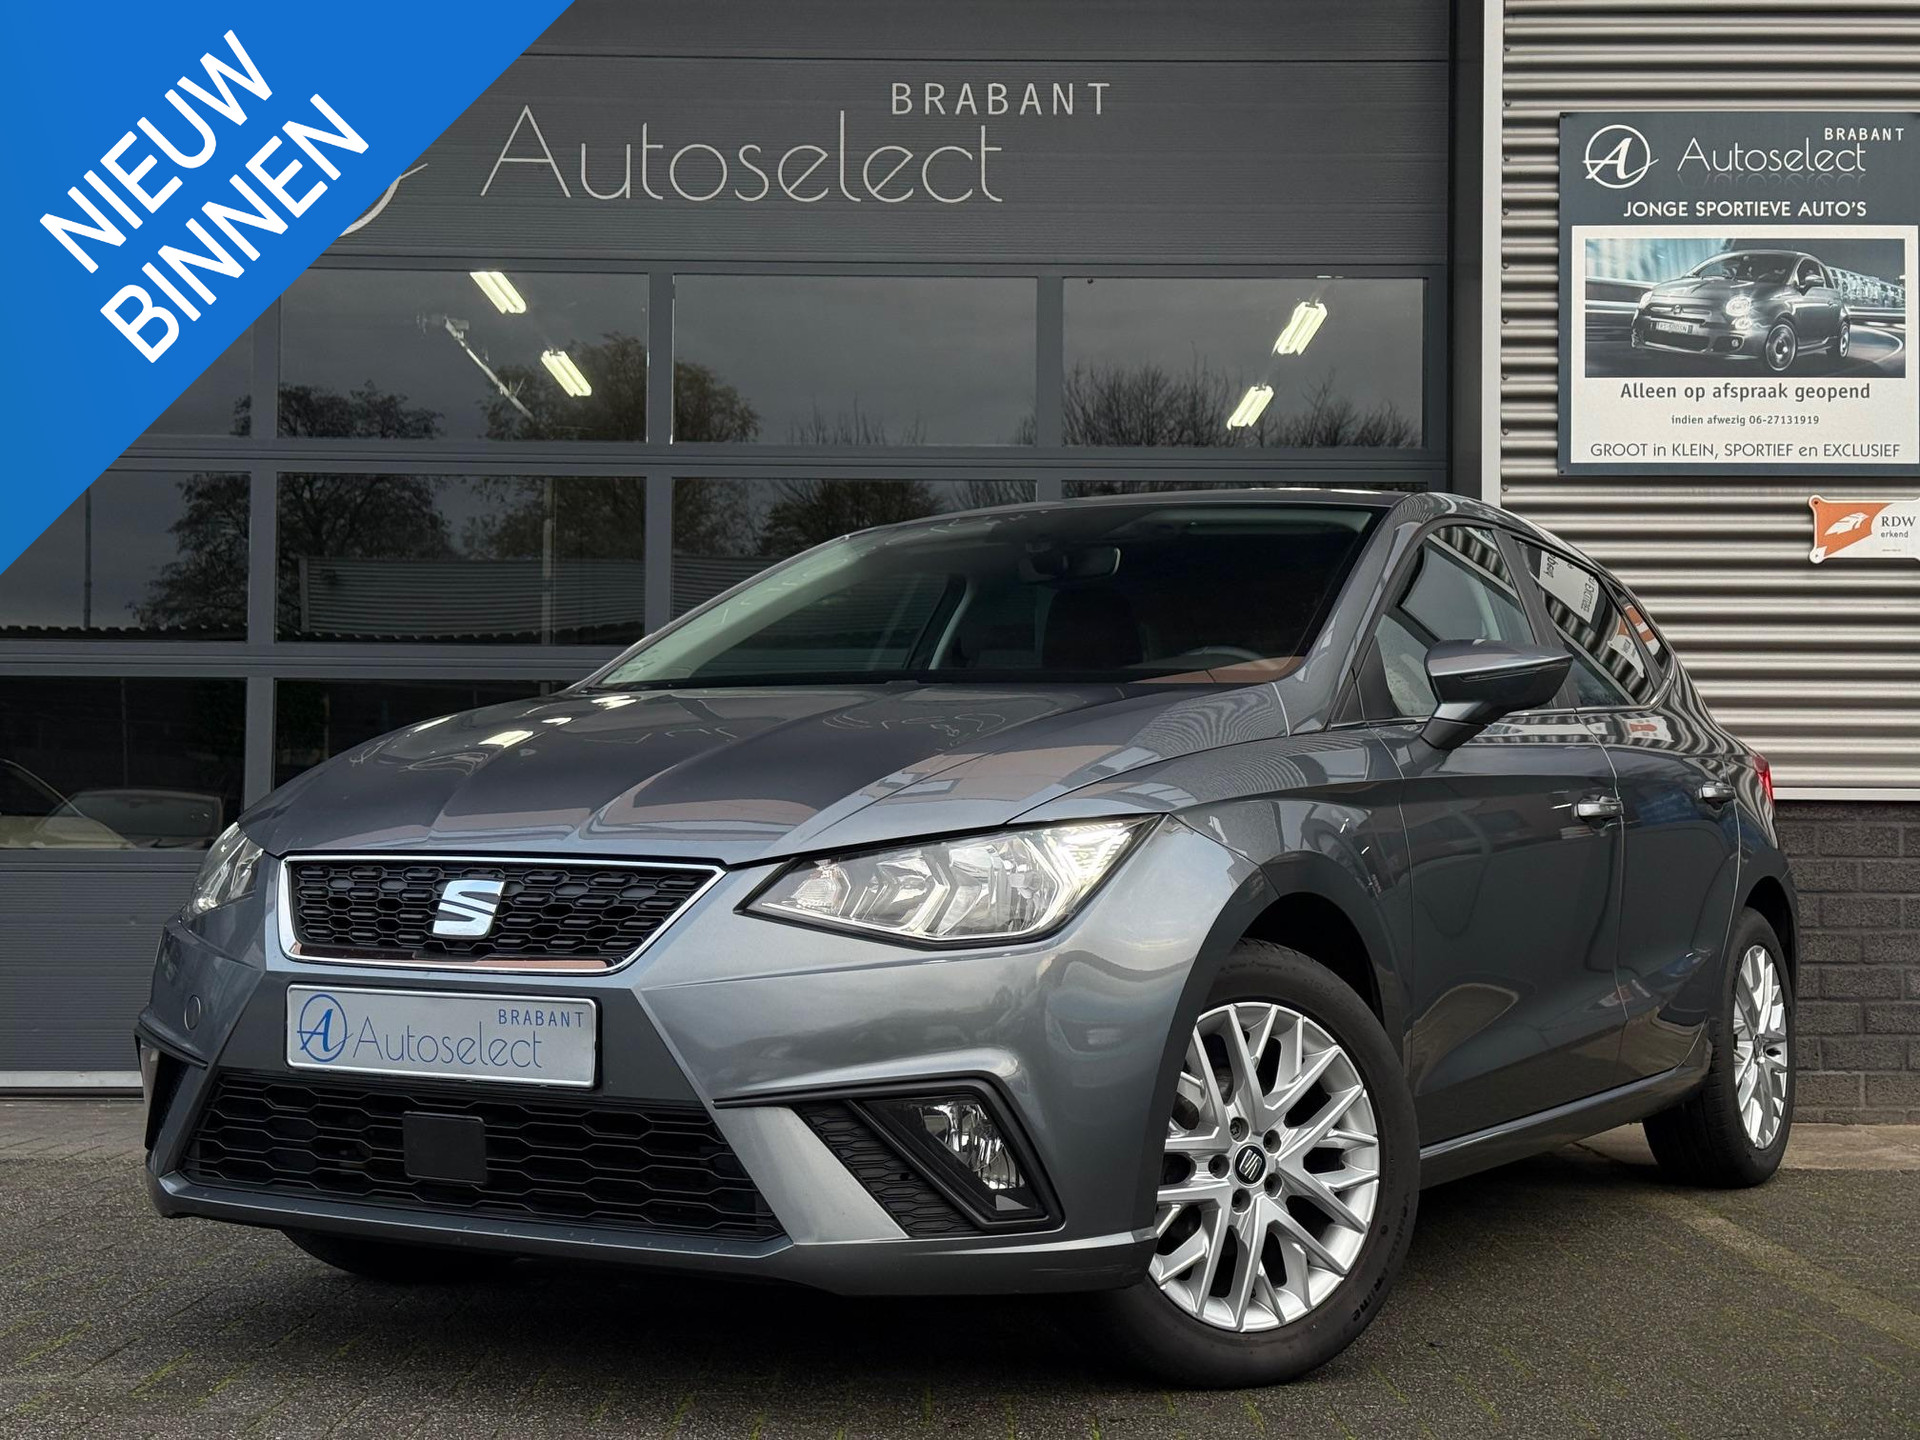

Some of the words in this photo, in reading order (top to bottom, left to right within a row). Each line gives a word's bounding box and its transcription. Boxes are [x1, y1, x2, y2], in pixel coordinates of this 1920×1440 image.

[891, 82, 1110, 115] BRABANT
[1824, 127, 1905, 141] BRABANT
[480, 105, 1004, 203] Autoselect
[1677, 137, 1867, 172] Autoselect
[1623, 201, 1688, 217] JONGE
[1695, 201, 1791, 217] SPORTIEVE
[1797, 201, 1867, 217] AUTO'S
[1620, 383, 1677, 399] Alleen
[1684, 386, 1706, 403] op
[1712, 383, 1788, 403] afspraak
[1794, 383, 1870, 403] geopend
[1671, 414, 1704, 425] indien
[1706, 414, 1746, 427] afwezig
[1748, 415, 1820, 425] 06-27131919
[1590, 443, 1648, 457] GROOT
[1653, 443, 1667, 457] in
[1672, 443, 1719, 460] KLEIN,
[1724, 443, 1794, 457] SPORTIEF
[1798, 446, 1818, 457] en
[1823, 443, 1901, 457] EXCLUSIEF
[1881, 515, 1916, 527] RDW
[1880, 530, 1909, 538] erkend
[498, 1008, 585, 1029] BRABANT
[353, 1016, 543, 1069] Autoselect
